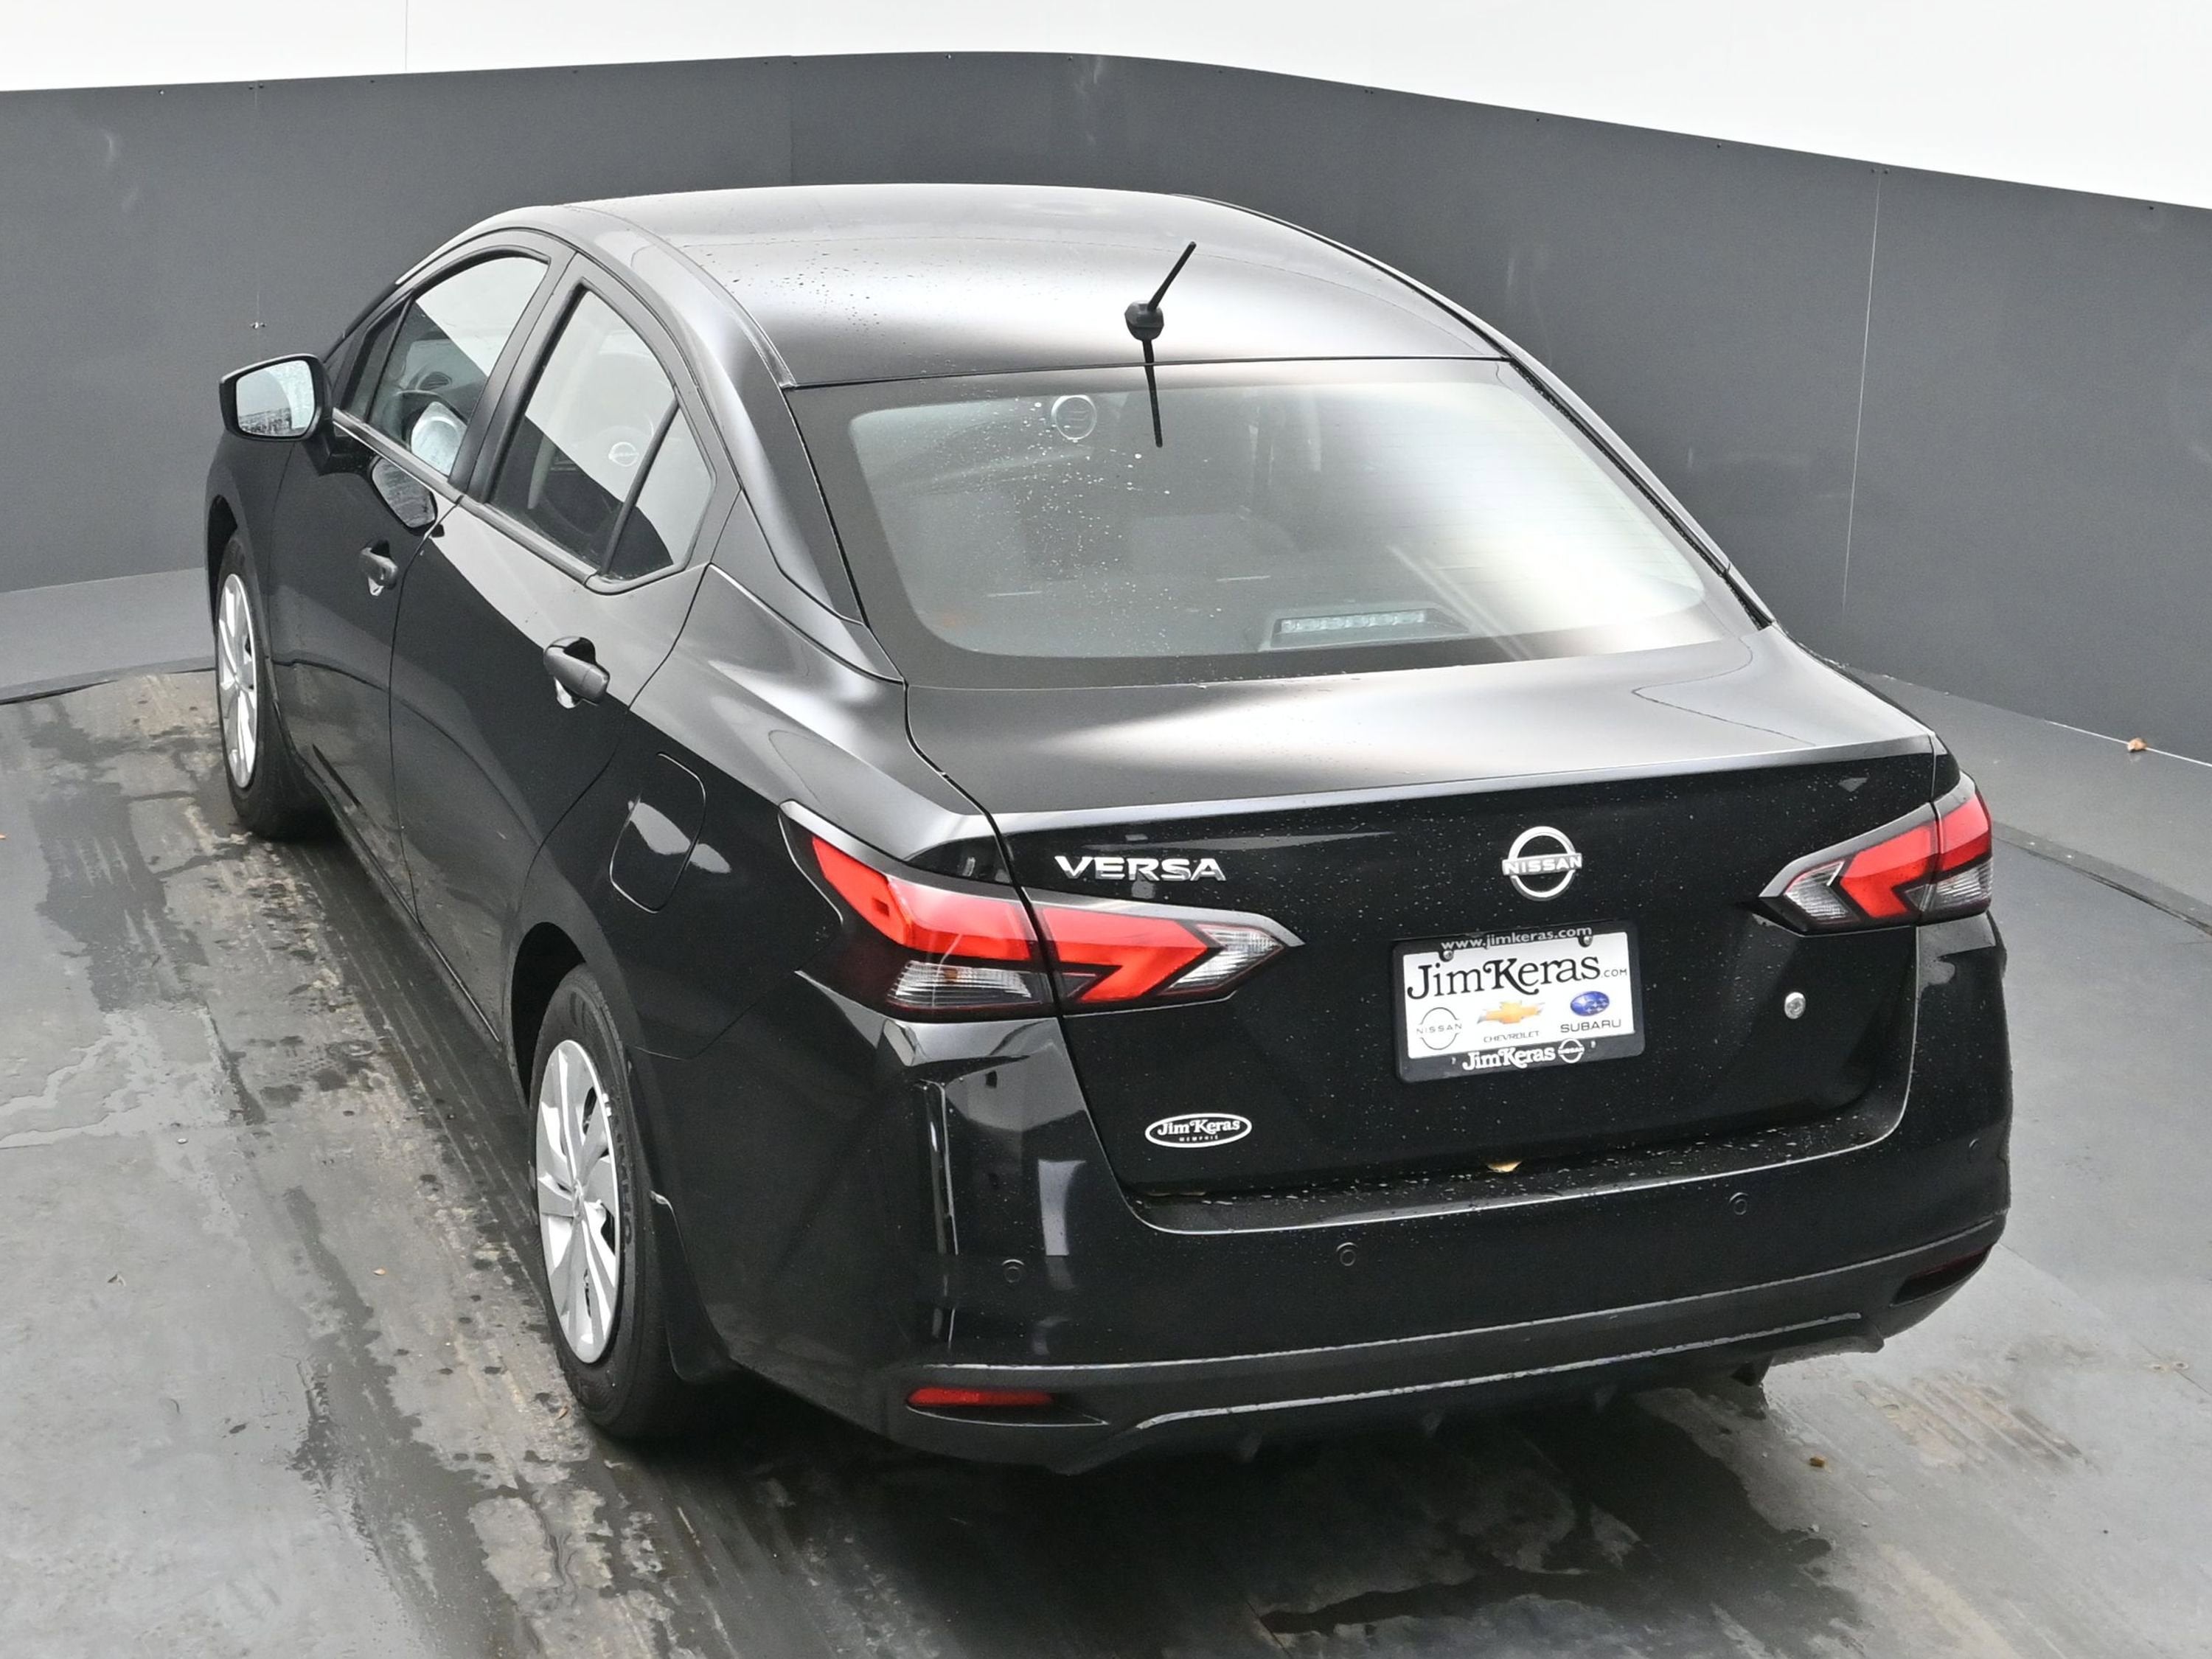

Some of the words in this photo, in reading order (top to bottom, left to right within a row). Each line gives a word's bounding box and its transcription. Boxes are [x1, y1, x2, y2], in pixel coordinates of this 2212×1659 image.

[1054, 855, 1226, 880] VERSA
[1504, 855, 1582, 874] NISSAN
[1441, 926, 1593, 950] www.jimkeras.com
[1416, 1023, 1462, 1034] NISSAN
[1560, 1019, 1621, 1033] SUBARU
[1484, 1031, 1540, 1043] CHEVROLET
